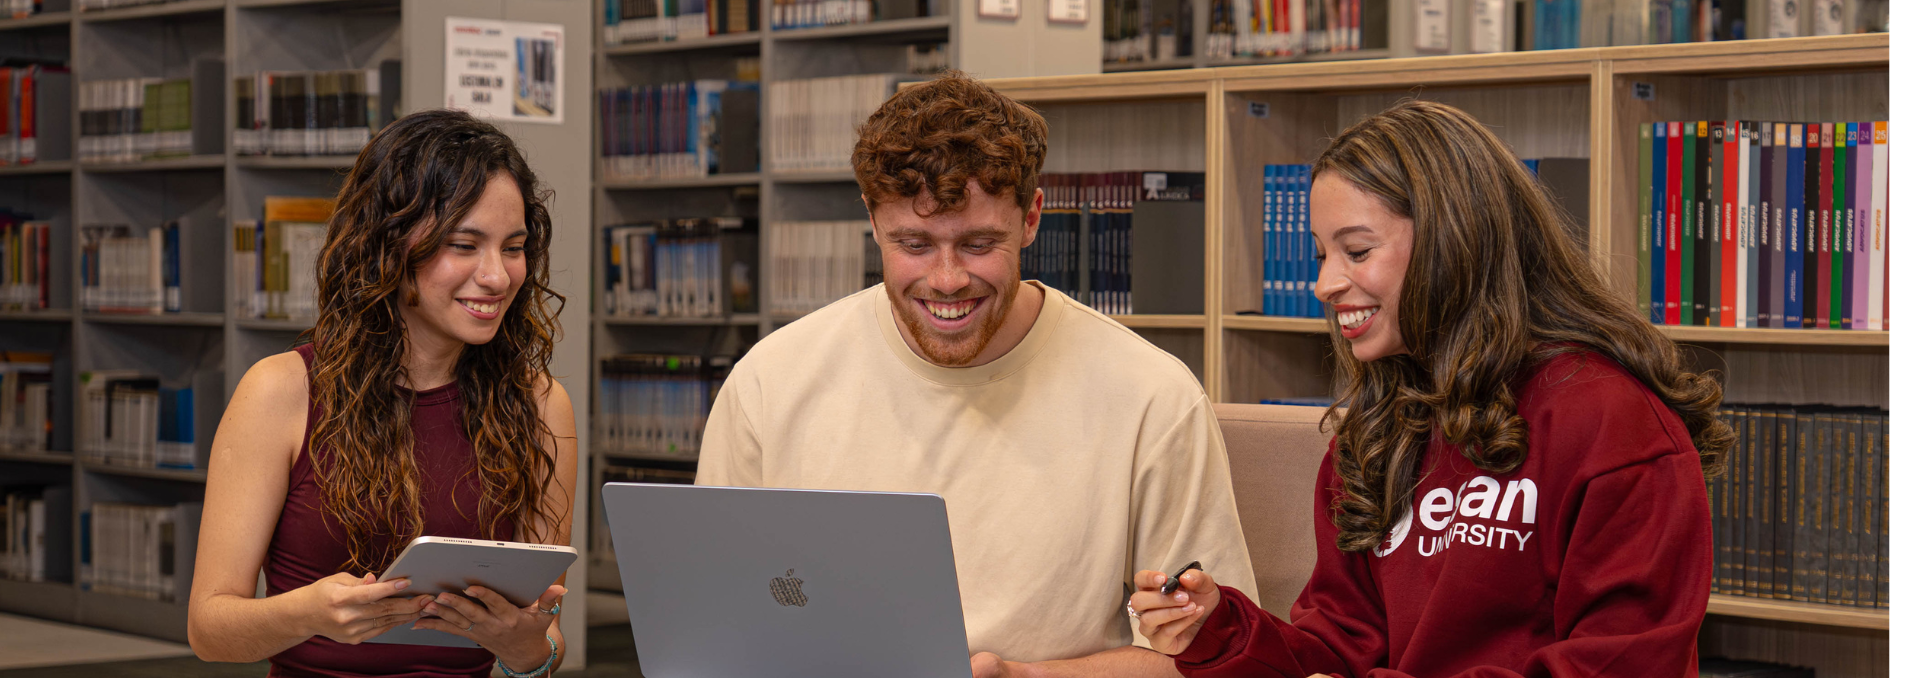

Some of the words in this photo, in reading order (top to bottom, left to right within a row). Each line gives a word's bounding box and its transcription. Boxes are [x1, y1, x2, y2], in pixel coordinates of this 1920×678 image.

[1715, 129, 1723, 138] 13
[1726, 128, 1736, 136] 14
[1750, 131, 1759, 140] 16
[1823, 132, 1832, 142] 21
[1836, 132, 1846, 143] 22
[1847, 131, 1858, 141] 23
[1860, 130, 1870, 142] 24
[1875, 130, 1887, 141] 25
[1808, 132, 1819, 144] 20
[1790, 207, 1798, 252] ADVOCATUS
[1821, 209, 1829, 253] ADVOCATUS
[1834, 209, 1842, 252] ADVOCATUS
[1846, 208, 1854, 252] ADVOCATUS
